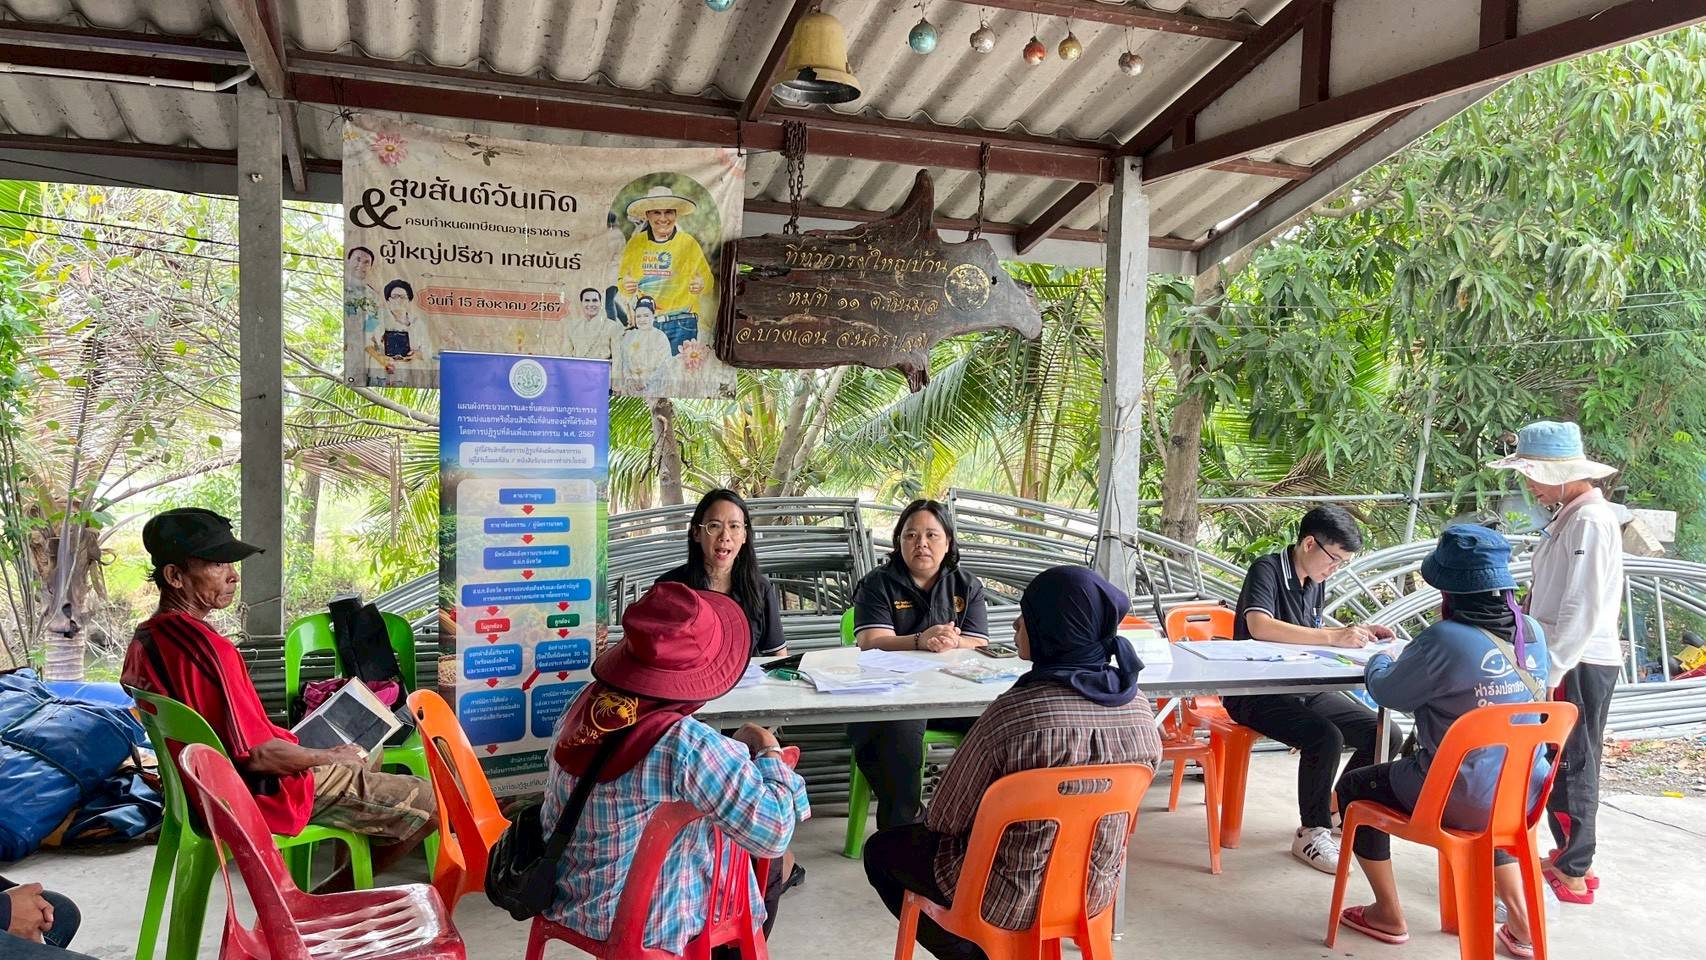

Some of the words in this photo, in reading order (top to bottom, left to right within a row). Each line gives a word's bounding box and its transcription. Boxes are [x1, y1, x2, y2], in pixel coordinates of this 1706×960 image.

[389, 175, 578, 213] สุขสันต์วันเกิด
[349, 187, 402, 231] &
[404, 216, 571, 238] ครบกำหนดเกษียณอายุราชการ
[379, 239, 494, 265] ผู้ใหญ่ปรีชา
[501, 250, 583, 271] เทสพันธ์
[427, 294, 454, 307] วันที่
[458, 297, 472, 307] 15
[476, 298, 527, 311] สิงหาคม
[530, 302, 562, 313] 2567
[836, 297, 860, 311] ๑๑
[735, 326, 828, 347] อ.บางเลน
